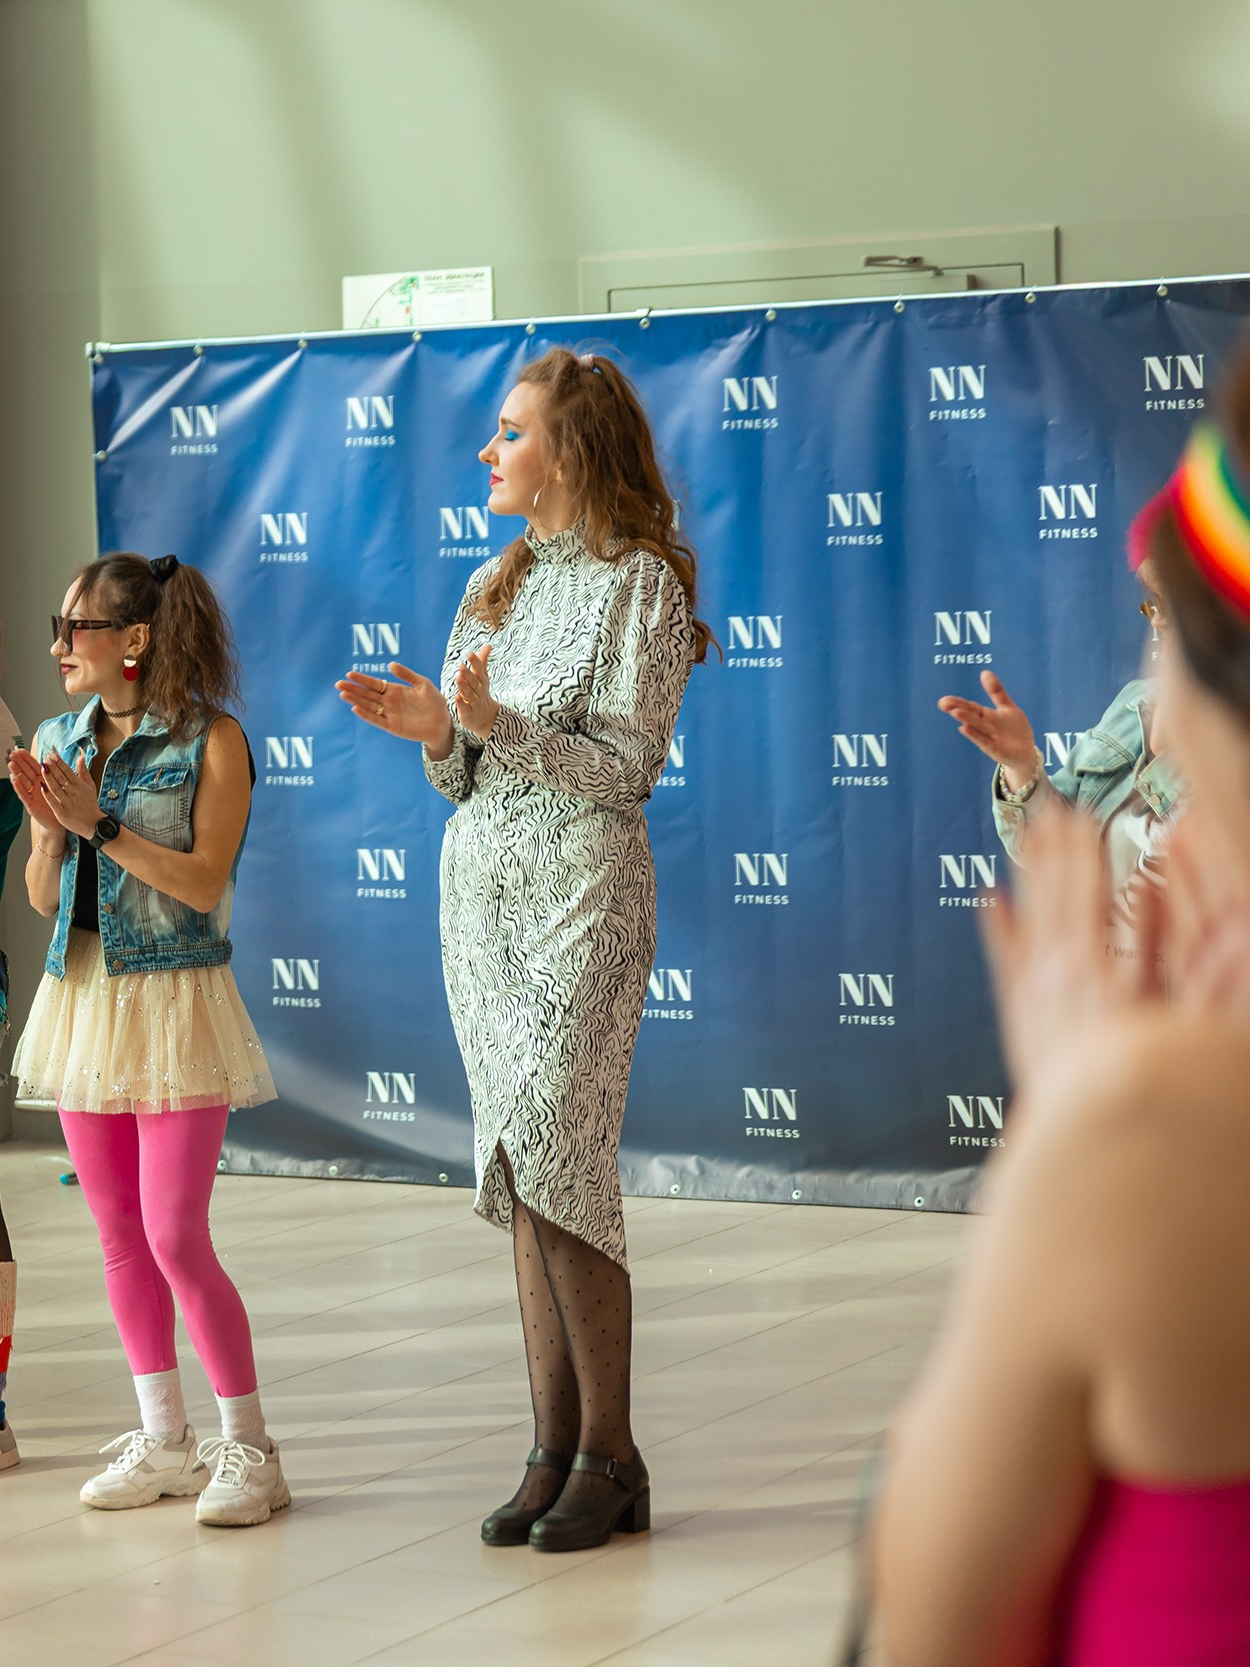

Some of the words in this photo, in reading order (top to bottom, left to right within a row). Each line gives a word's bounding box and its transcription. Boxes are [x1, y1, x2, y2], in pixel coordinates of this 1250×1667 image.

[929, 364, 986, 402] NN
[1142, 354, 1204, 392] NN
[721, 375, 778, 412] NN
[1145, 398, 1205, 411] FITNESS
[169, 403, 218, 439] NN
[345, 394, 394, 430] NN
[722, 417, 779, 430] FITNESS
[929, 408, 986, 420] FITNESS
[170, 443, 219, 456] FITNESS
[345, 436, 395, 447] FITNESS
[827, 491, 882, 528] NN
[1038, 483, 1098, 520] NN
[260, 511, 308, 545] NN
[439, 505, 489, 540] NN
[1039, 527, 1098, 539] FITNESS
[439, 545, 490, 557] FITNESS
[827, 534, 883, 546] FITNESS
[260, 552, 308, 562] FITNESS
[352, 623, 400, 656] NN
[727, 615, 783, 650] NN
[933, 610, 992, 646] NN
[351, 661, 391, 674] FITNE
[728, 657, 783, 668] FITNESS
[934, 653, 993, 664] FITNESS
[265, 736, 313, 769] NN
[831, 733, 888, 768] NN
[1042, 731, 1087, 767] N
[266, 775, 314, 785] FITNESS
[832, 776, 889, 786] FITNESS
[356, 848, 406, 881] NN
[733, 853, 788, 887] NN
[938, 854, 997, 889] NN
[357, 888, 407, 899] FITNESS
[734, 894, 789, 905] FITNESS
[938, 896, 997, 908] FITNESS
[271, 958, 320, 991] NN
[641, 967, 694, 1002] NN
[838, 973, 894, 1007] NN
[272, 996, 321, 1008] FITNESS
[640, 1008, 695, 1021] FITNESS
[839, 1014, 896, 1026] FITNESS
[365, 1071, 415, 1104] NN
[742, 1087, 797, 1121] NN
[362, 1110, 416, 1122] FITNESS
[946, 1094, 1004, 1130] NN
[745, 1127, 800, 1139] FITNESS
[949, 1135, 1006, 1148] FITNESS
